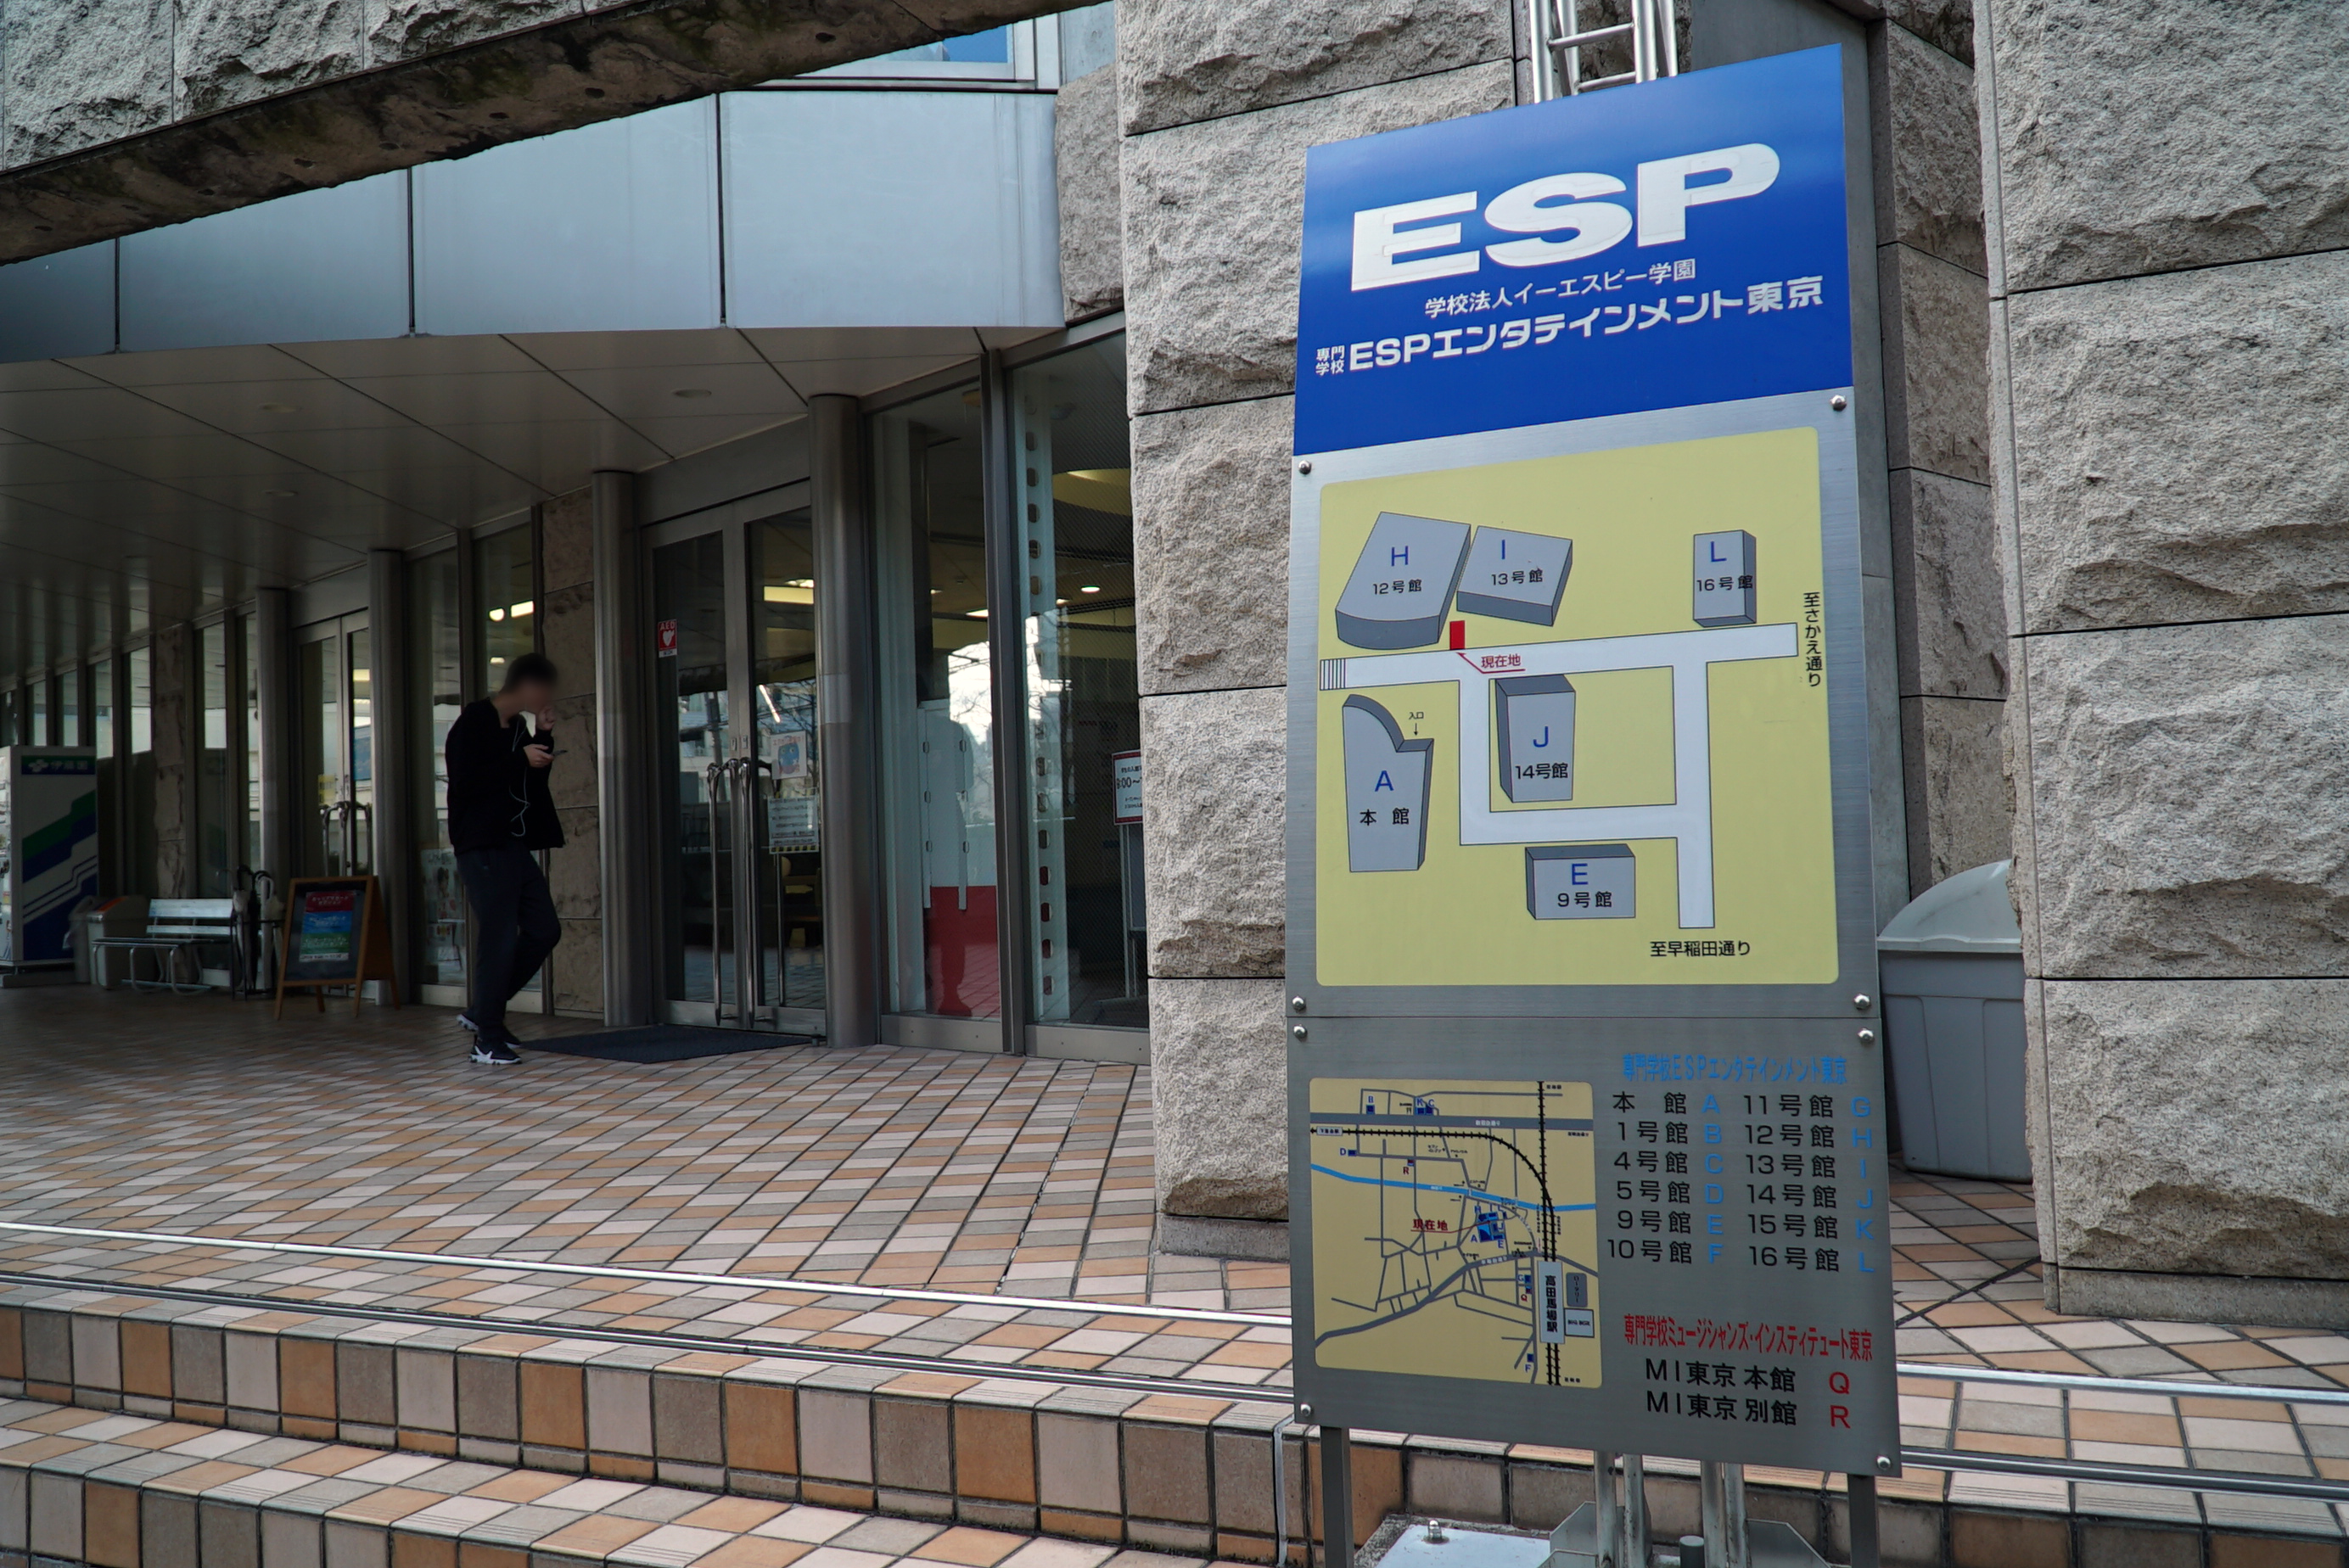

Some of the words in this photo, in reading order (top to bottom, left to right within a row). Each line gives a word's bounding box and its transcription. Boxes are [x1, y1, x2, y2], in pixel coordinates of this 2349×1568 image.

[1351, 143, 1780, 291] ESP
[1425, 258, 1696, 318] 学校法人イーエスピー学園
[1349, 275, 1824, 371] ESPエンタテインメント東京
[1316, 345, 1345, 361] 専門
[1315, 360, 1344, 376] 学校
[1391, 546, 1409, 567] H
[1501, 540, 1505, 560] I
[1710, 540, 1727, 563] L
[1372, 580, 1422, 595] 12号館
[1491, 568, 1544, 585] 13号館
[1696, 574, 1753, 591] 16号館
[1803, 591, 1823, 687] 至さかえ通り
[1481, 653, 1522, 669] 現在地
[1533, 725, 1549, 748] J
[1374, 770, 1394, 792] A
[1514, 762, 1568, 780] 14号館
[1571, 863, 1589, 885] E
[1557, 891, 1612, 909] 9号館
[1650, 939, 1751, 957] 至早稲田通り
[1622, 1053, 1847, 1085] 専門学校ESPエンタテインメント東京
[1701, 1094, 1720, 1114] A
[1743, 1094, 1833, 1118] 11号館
[1851, 1096, 1871, 1117] G
[1617, 1121, 1688, 1145] 1号館
[1704, 1123, 1722, 1144] B
[1744, 1123, 1835, 1148] 12号館
[1852, 1128, 1872, 1149] H
[1613, 1151, 1688, 1174] 4号館
[1704, 1153, 1724, 1174] C
[1746, 1153, 1836, 1179] 13号館
[1860, 1158, 1866, 1179] I
[1617, 1180, 1690, 1205] 5号館
[1704, 1184, 1724, 1204] D
[1746, 1184, 1836, 1209] 14号館
[1856, 1189, 1873, 1209] J
[1413, 1218, 1448, 1230] 現在地
[1617, 1210, 1691, 1235] 9号館
[1707, 1214, 1724, 1235] E
[1748, 1213, 1838, 1240] 15号館
[1855, 1218, 1875, 1240] K
[1607, 1239, 1692, 1264] 10号館
[1708, 1243, 1724, 1264] F
[1748, 1246, 1839, 1273] 16号館
[1858, 1252, 1875, 1274] L
[1829, 1372, 1851, 1395] Q
[1830, 1405, 1851, 1429] R
